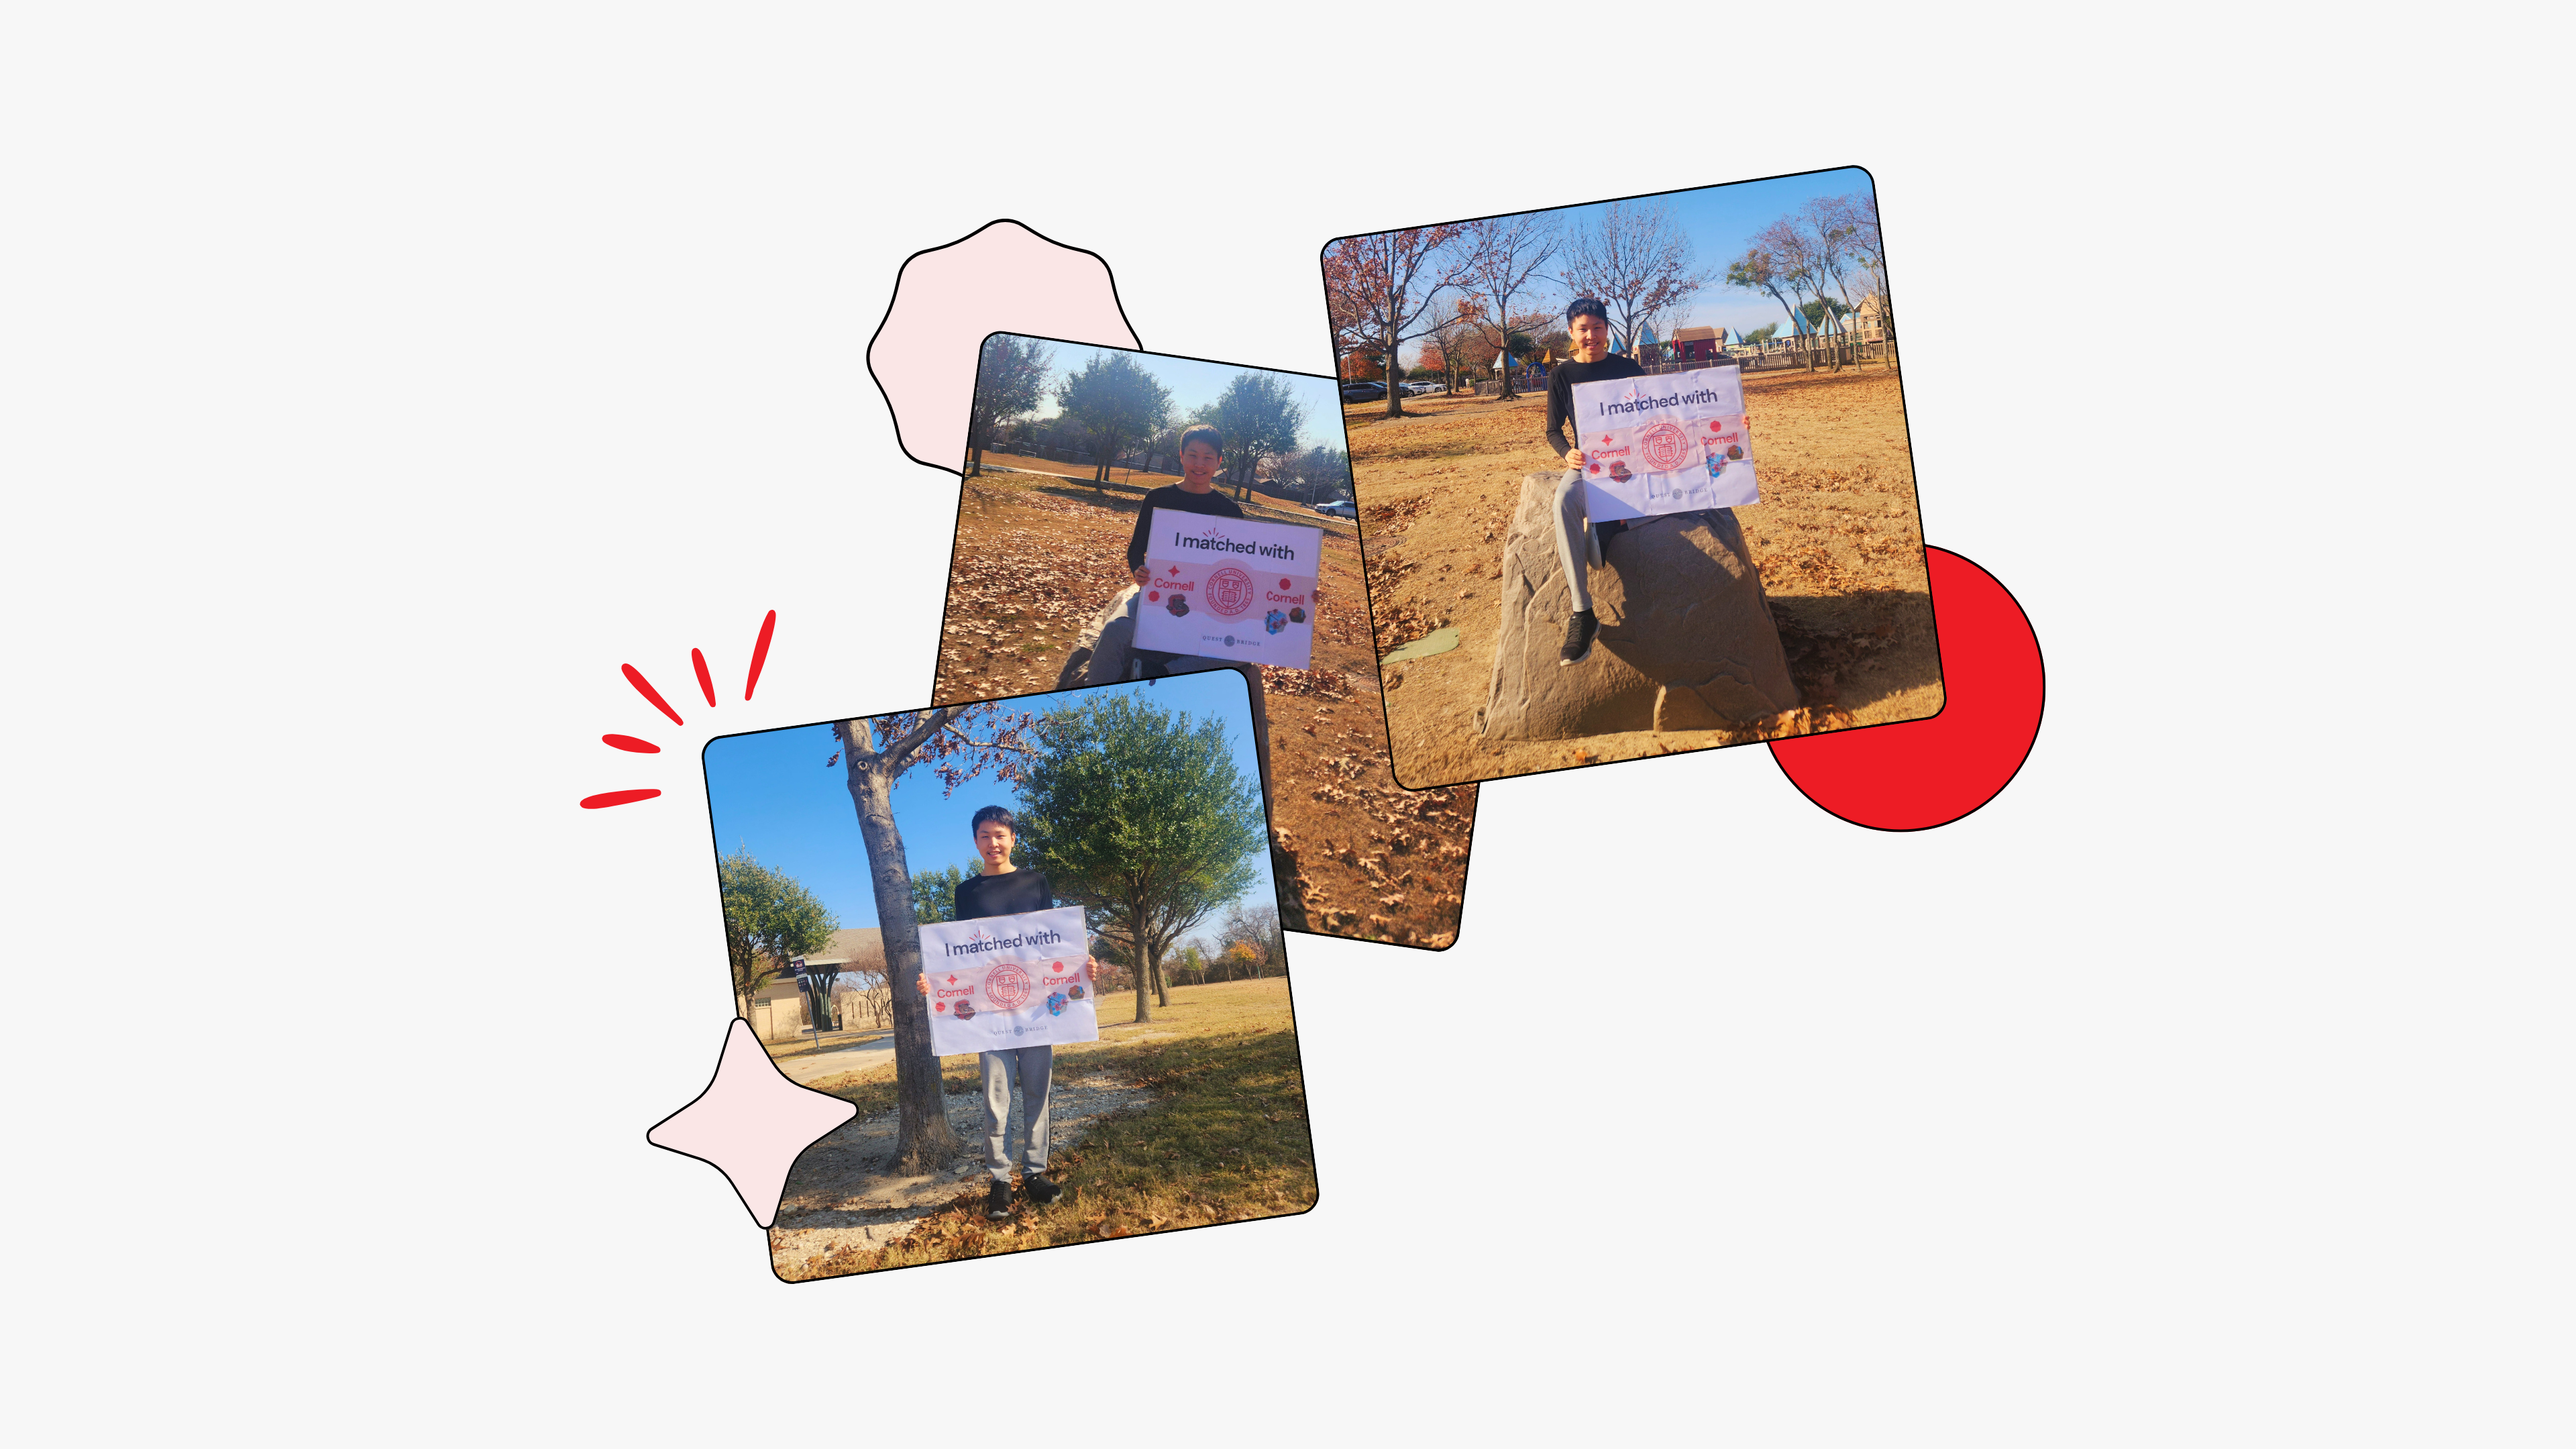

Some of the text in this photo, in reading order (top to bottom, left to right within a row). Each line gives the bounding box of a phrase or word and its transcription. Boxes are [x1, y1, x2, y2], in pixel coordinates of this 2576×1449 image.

[1600, 388, 1718, 416] I matched with
[1644, 425, 1686, 449] CORNELL UNIVERSITY
[1701, 432, 1739, 446] Cornell
[1591, 445, 1630, 460] Cornell
[1646, 452, 1668, 468] FOUNDED
[1175, 532, 1295, 560] I matched with
[1154, 578, 1195, 592] Cornell
[1208, 570, 1251, 595] CORNELL UNIVERSITY
[1267, 591, 1305, 605] Cornell
[945, 930, 1061, 957] I matched with
[987, 965, 1028, 989] CORNELL UNIVERSITY
[1042, 973, 1080, 986] Cornell
[937, 985, 974, 998] Cornell
[989, 992, 1011, 1008] FOUNDED
